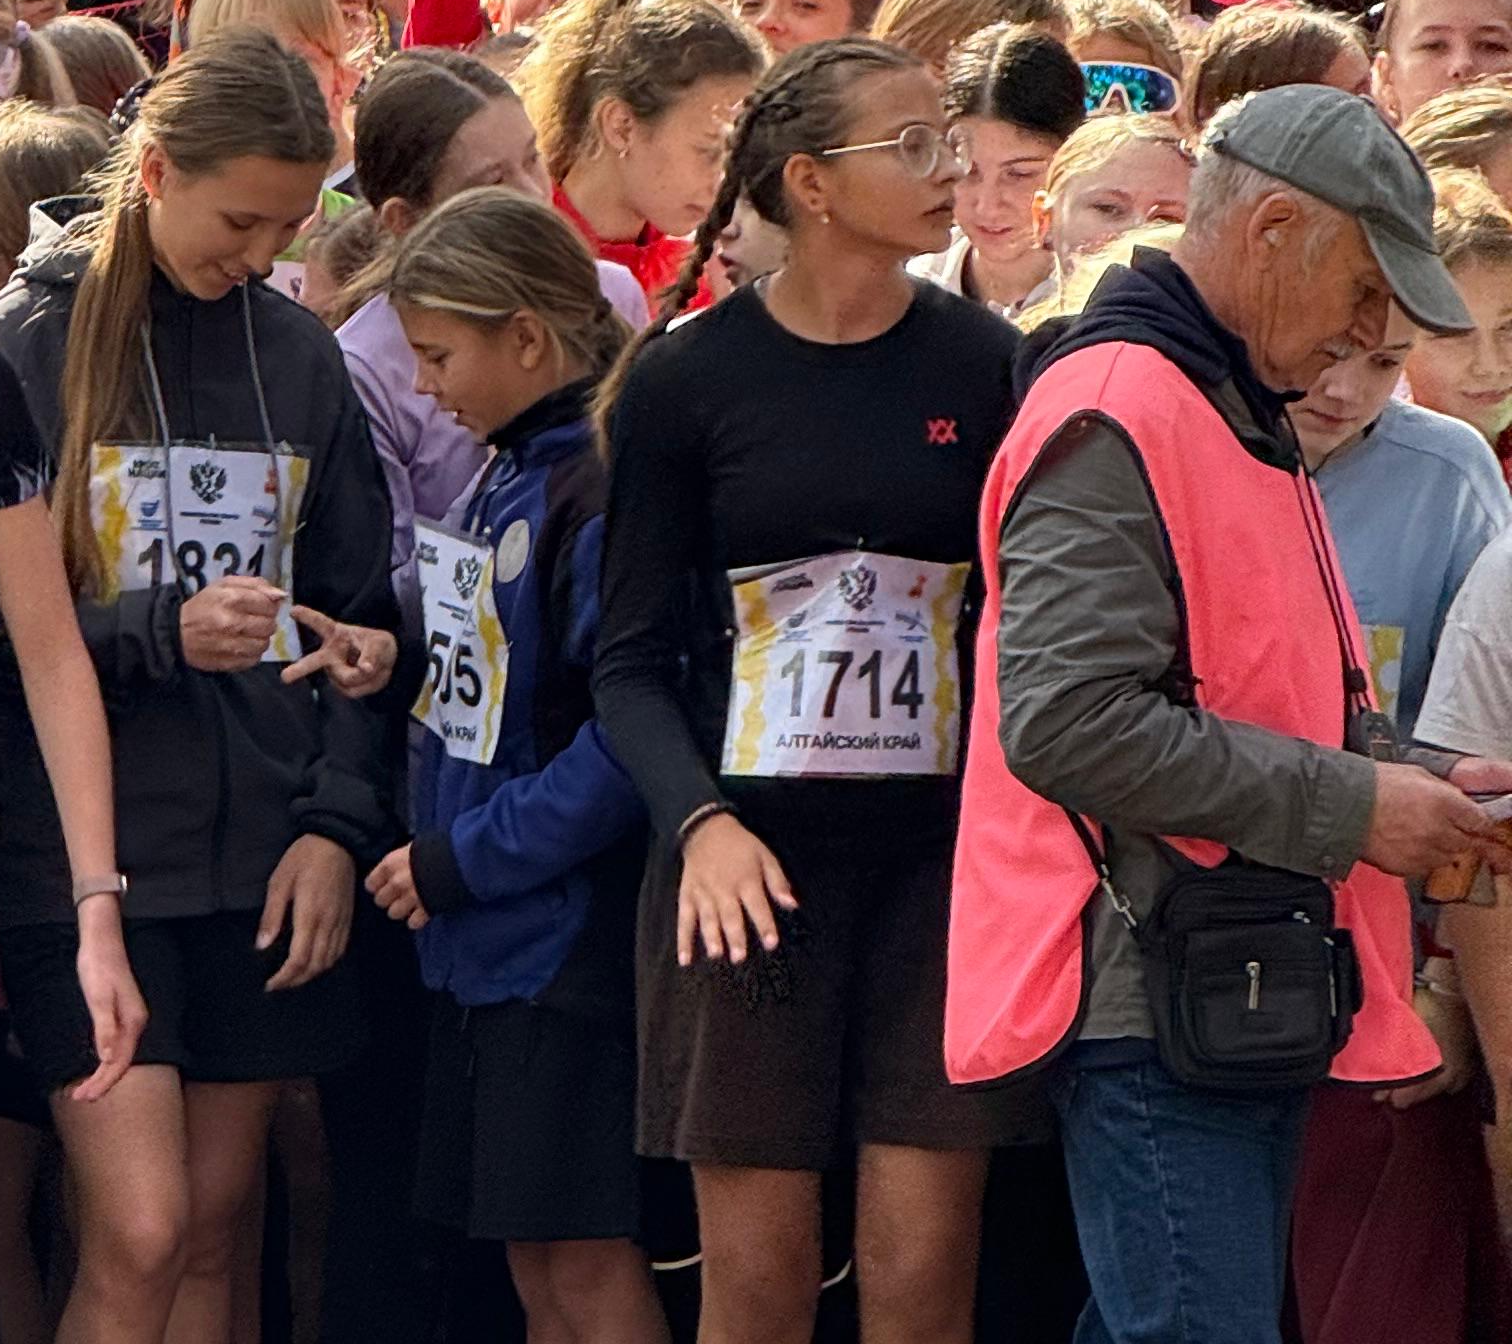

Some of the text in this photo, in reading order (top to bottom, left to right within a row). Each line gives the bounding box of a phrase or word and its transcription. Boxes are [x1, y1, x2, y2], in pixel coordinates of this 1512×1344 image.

[780, 649, 925, 719] 1714
[776, 732, 921, 751] АЛТАЙСКИЙ КРАЙ
